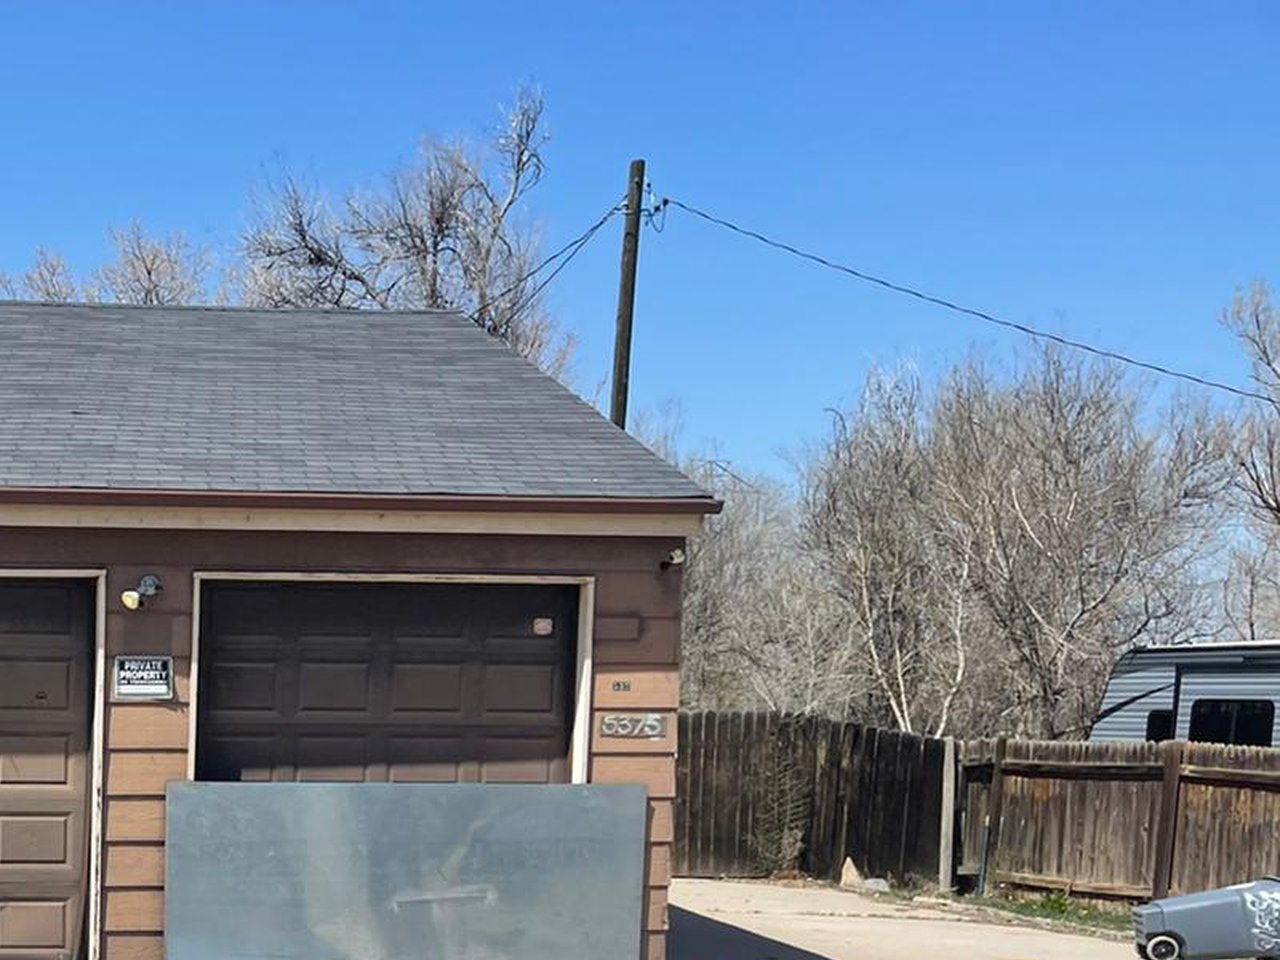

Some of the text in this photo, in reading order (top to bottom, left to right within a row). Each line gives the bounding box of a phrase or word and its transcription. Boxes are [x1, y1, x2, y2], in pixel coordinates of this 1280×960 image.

[124, 660, 163, 670] PRIVATE
[119, 670, 167, 680] PROPERTY
[601, 712, 662, 736] 5375
